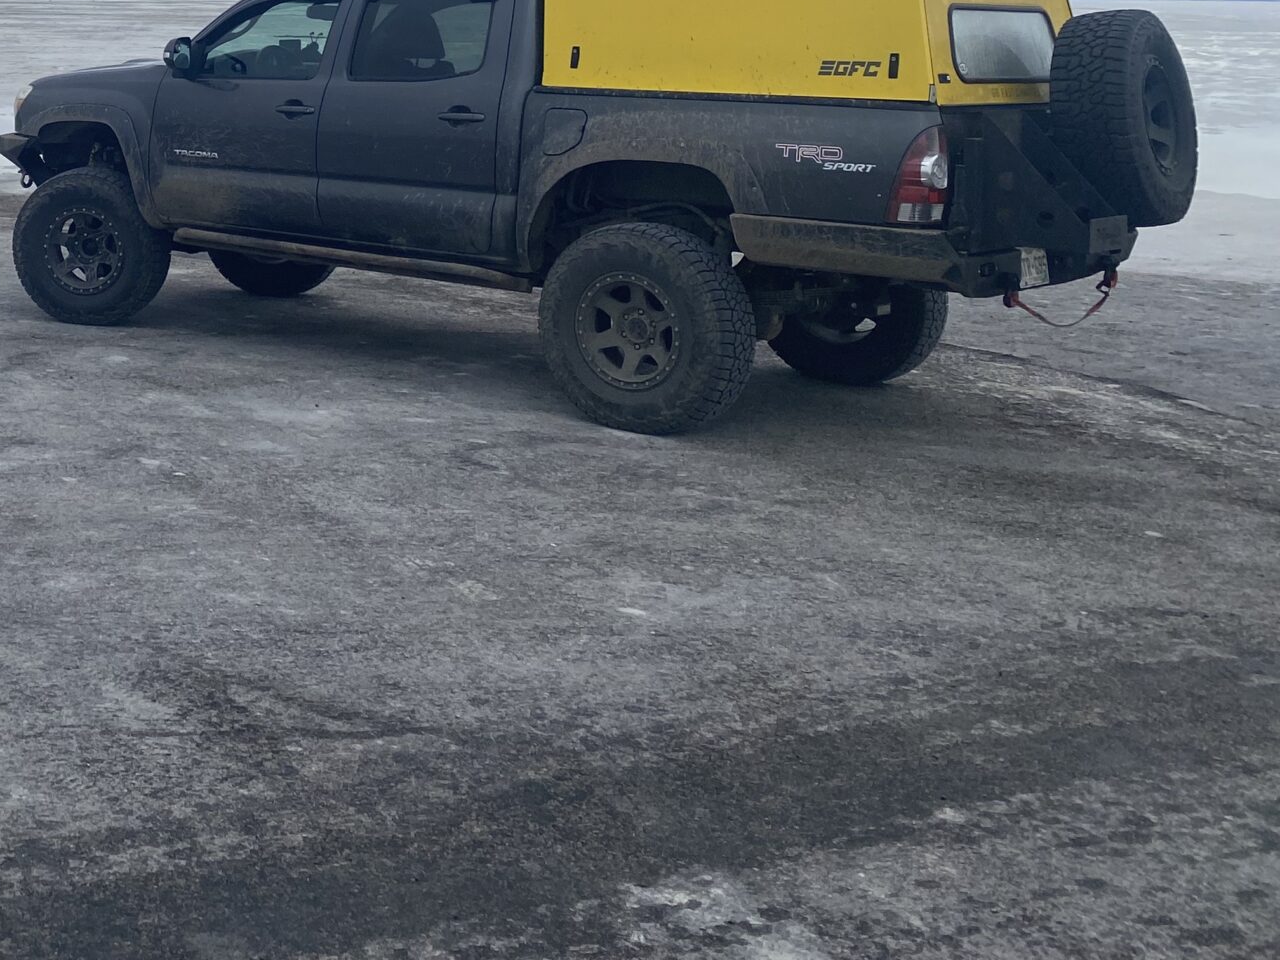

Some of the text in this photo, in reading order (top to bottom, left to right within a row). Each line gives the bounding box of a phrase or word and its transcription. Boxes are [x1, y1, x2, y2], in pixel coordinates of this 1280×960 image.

[173, 149, 219, 159] TACOMA
[776, 143, 843, 164] TRD
[823, 162, 876, 172] SPORT
